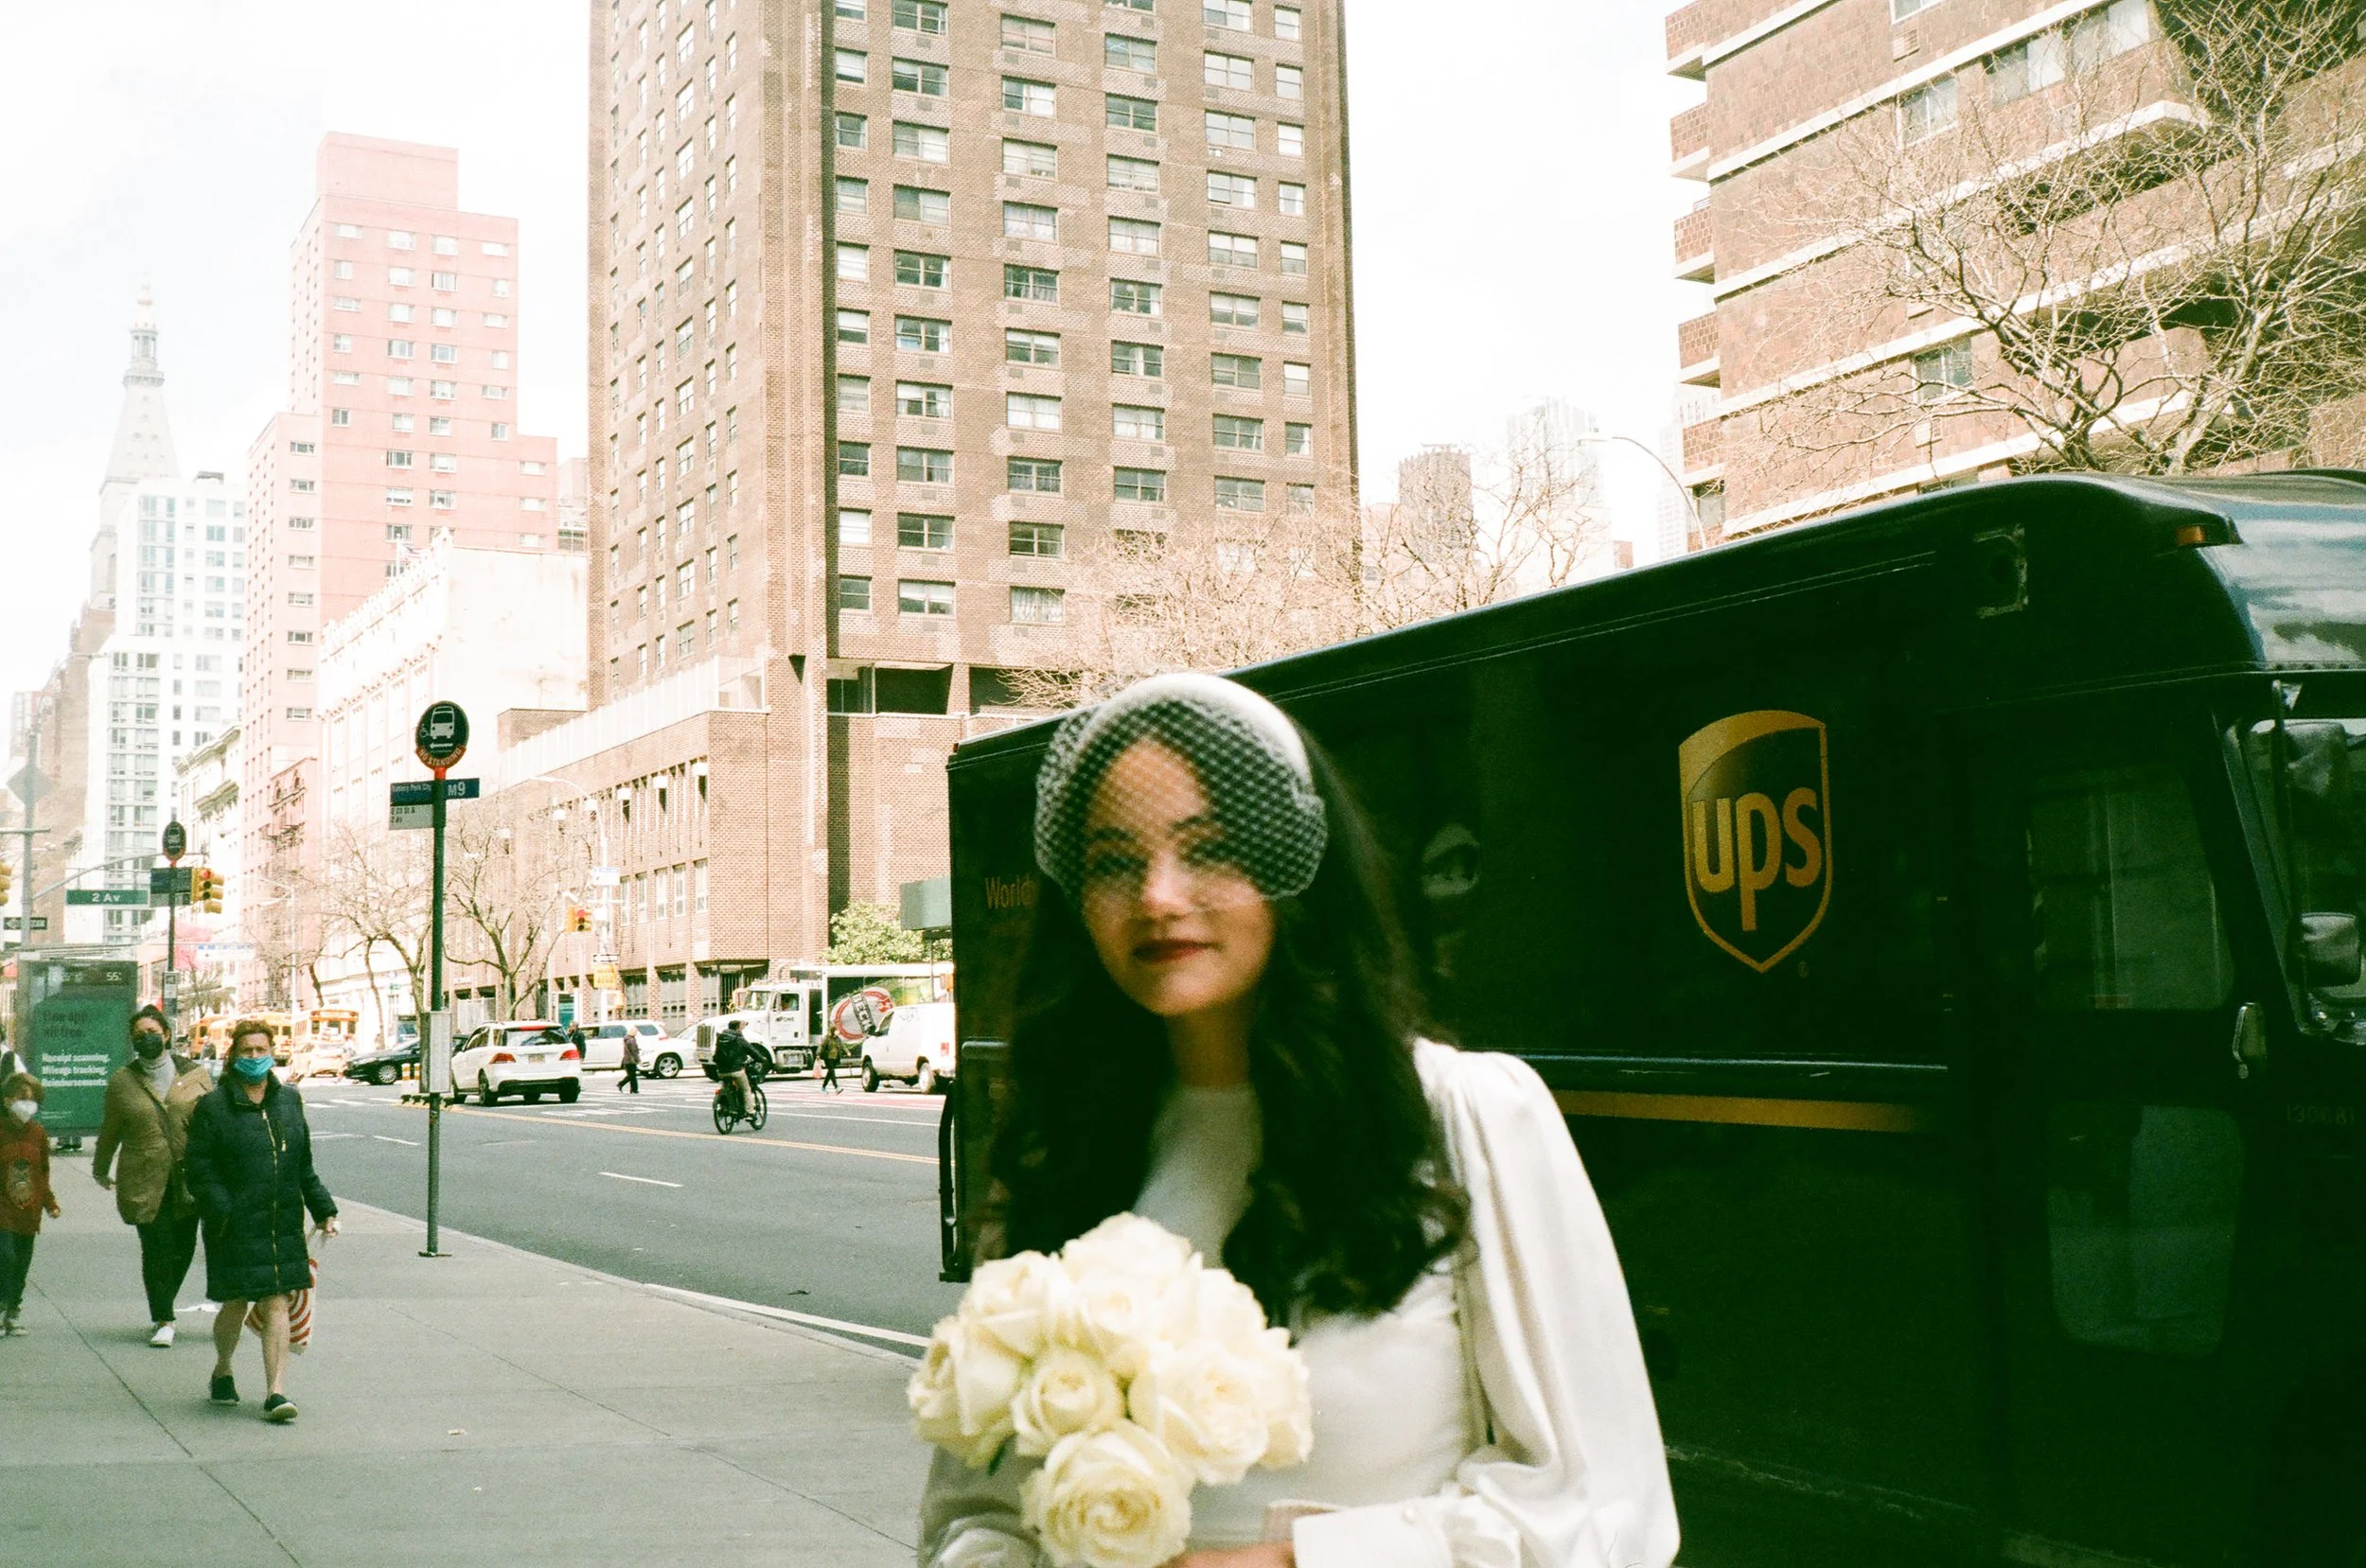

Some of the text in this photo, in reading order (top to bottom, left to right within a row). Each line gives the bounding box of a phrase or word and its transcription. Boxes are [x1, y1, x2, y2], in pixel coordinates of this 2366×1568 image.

[427, 747, 462, 766] STANDING
[448, 781, 466, 797] M9
[1692, 786, 1822, 932] ups
[92, 892, 121, 903] 2 Av
[852, 992, 874, 1032] BECK
